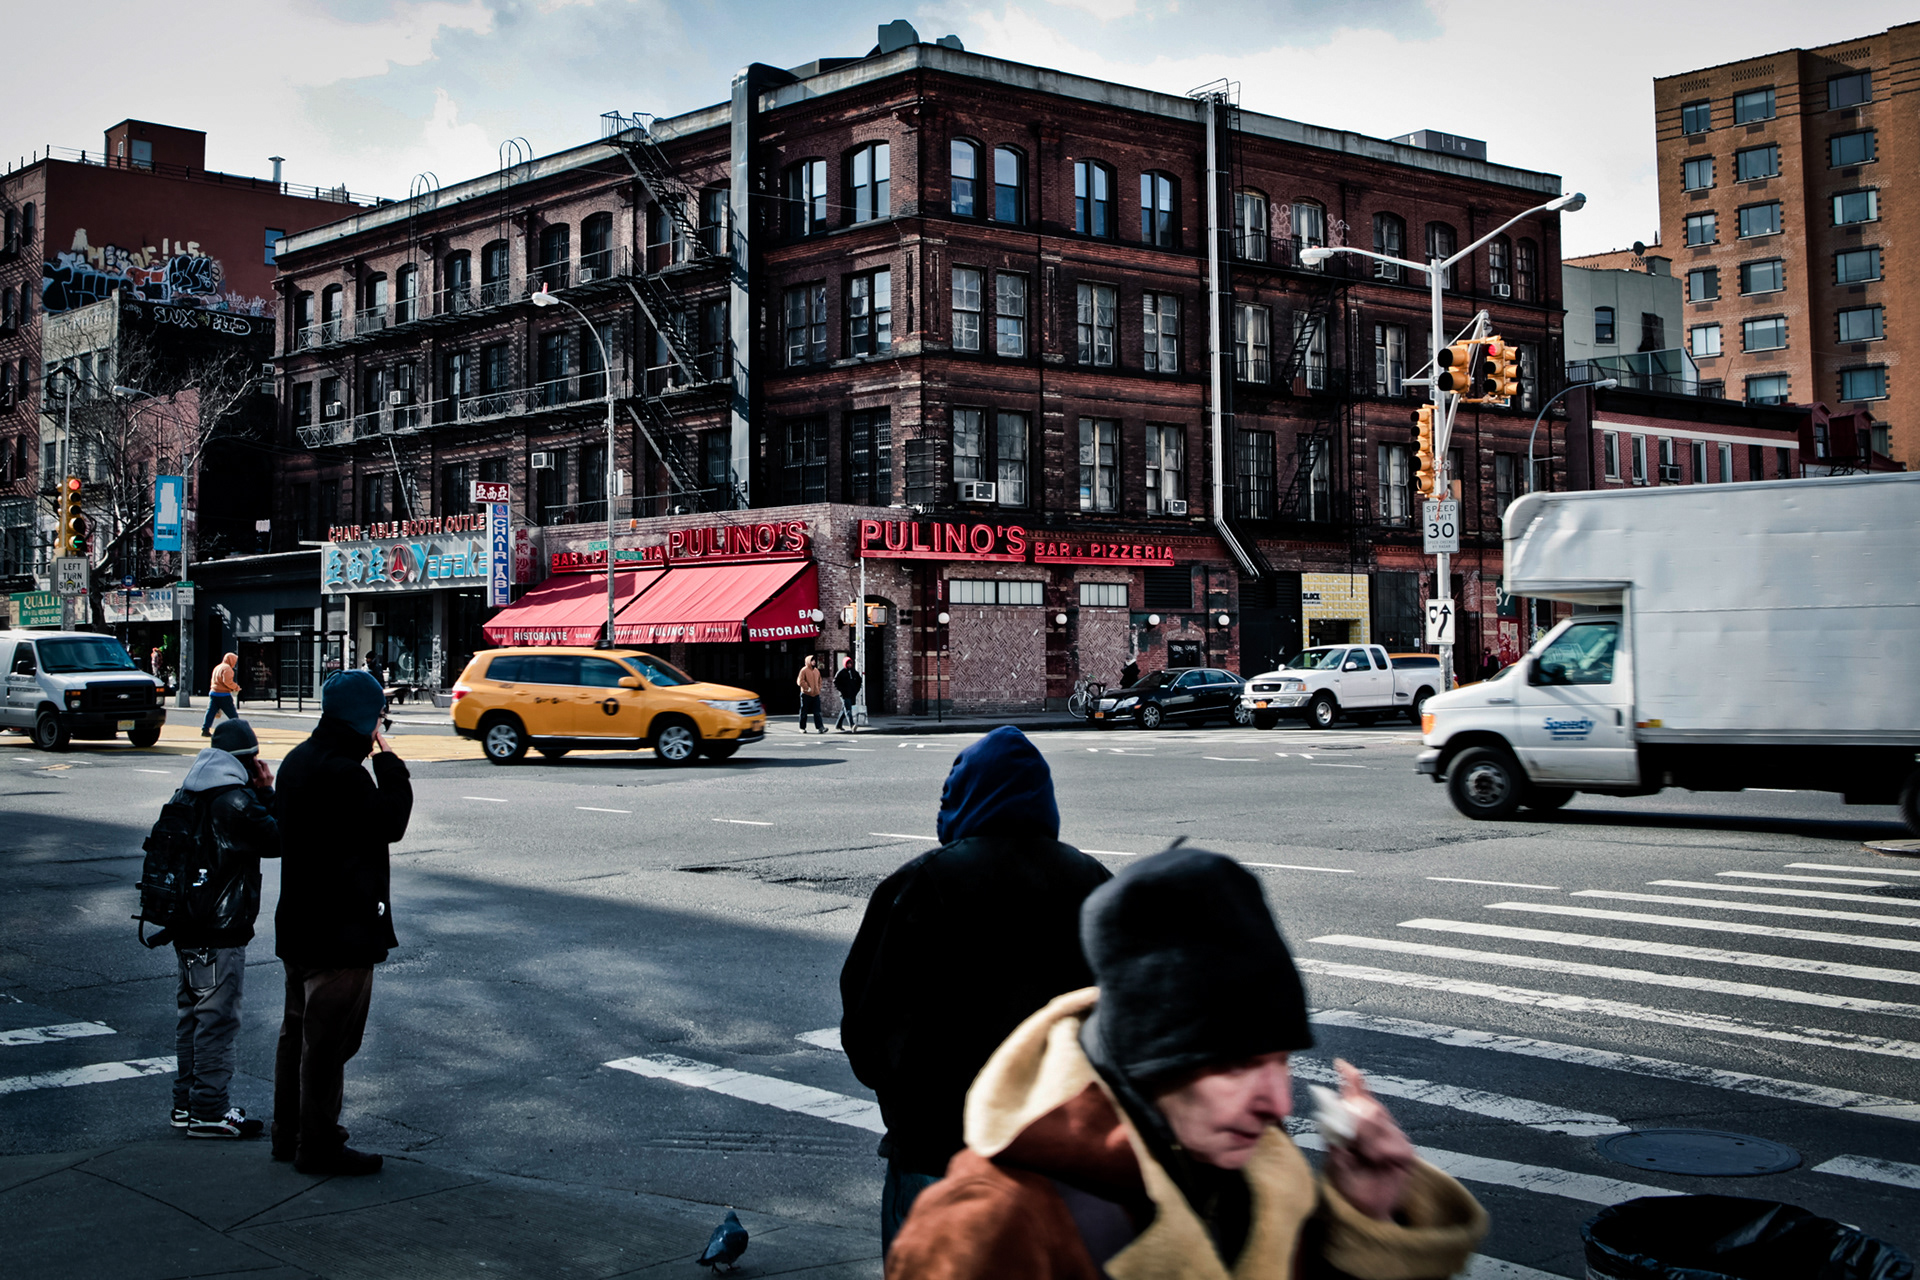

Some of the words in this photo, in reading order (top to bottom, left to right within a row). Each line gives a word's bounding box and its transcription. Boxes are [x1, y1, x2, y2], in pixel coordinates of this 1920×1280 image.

[1426, 504, 1456, 512] SPEED
[1429, 513, 1453, 521] LIMIT
[328, 524, 361, 542] CHAIR
[401, 516, 442, 537] BOOTH
[445, 512, 487, 533] OUTLE
[1428, 522, 1455, 539] 30
[493, 518, 507, 560] CHAIR
[668, 520, 806, 558] PULINO'S
[860, 519, 1027, 555] PULINO'S
[1034, 542, 1071, 556] BAR
[1090, 543, 1175, 560] PIZZERIA
[410, 540, 487, 582] Yasaka
[552, 552, 579, 566] BAR
[63, 563, 81, 571] LEFT
[63, 572, 82, 580] TURN
[494, 563, 508, 605] TABLE
[513, 631, 568, 641] RISTORANTE
[649, 626, 695, 637] PULINO'S
[749, 623, 821, 638] RISTORANTE
